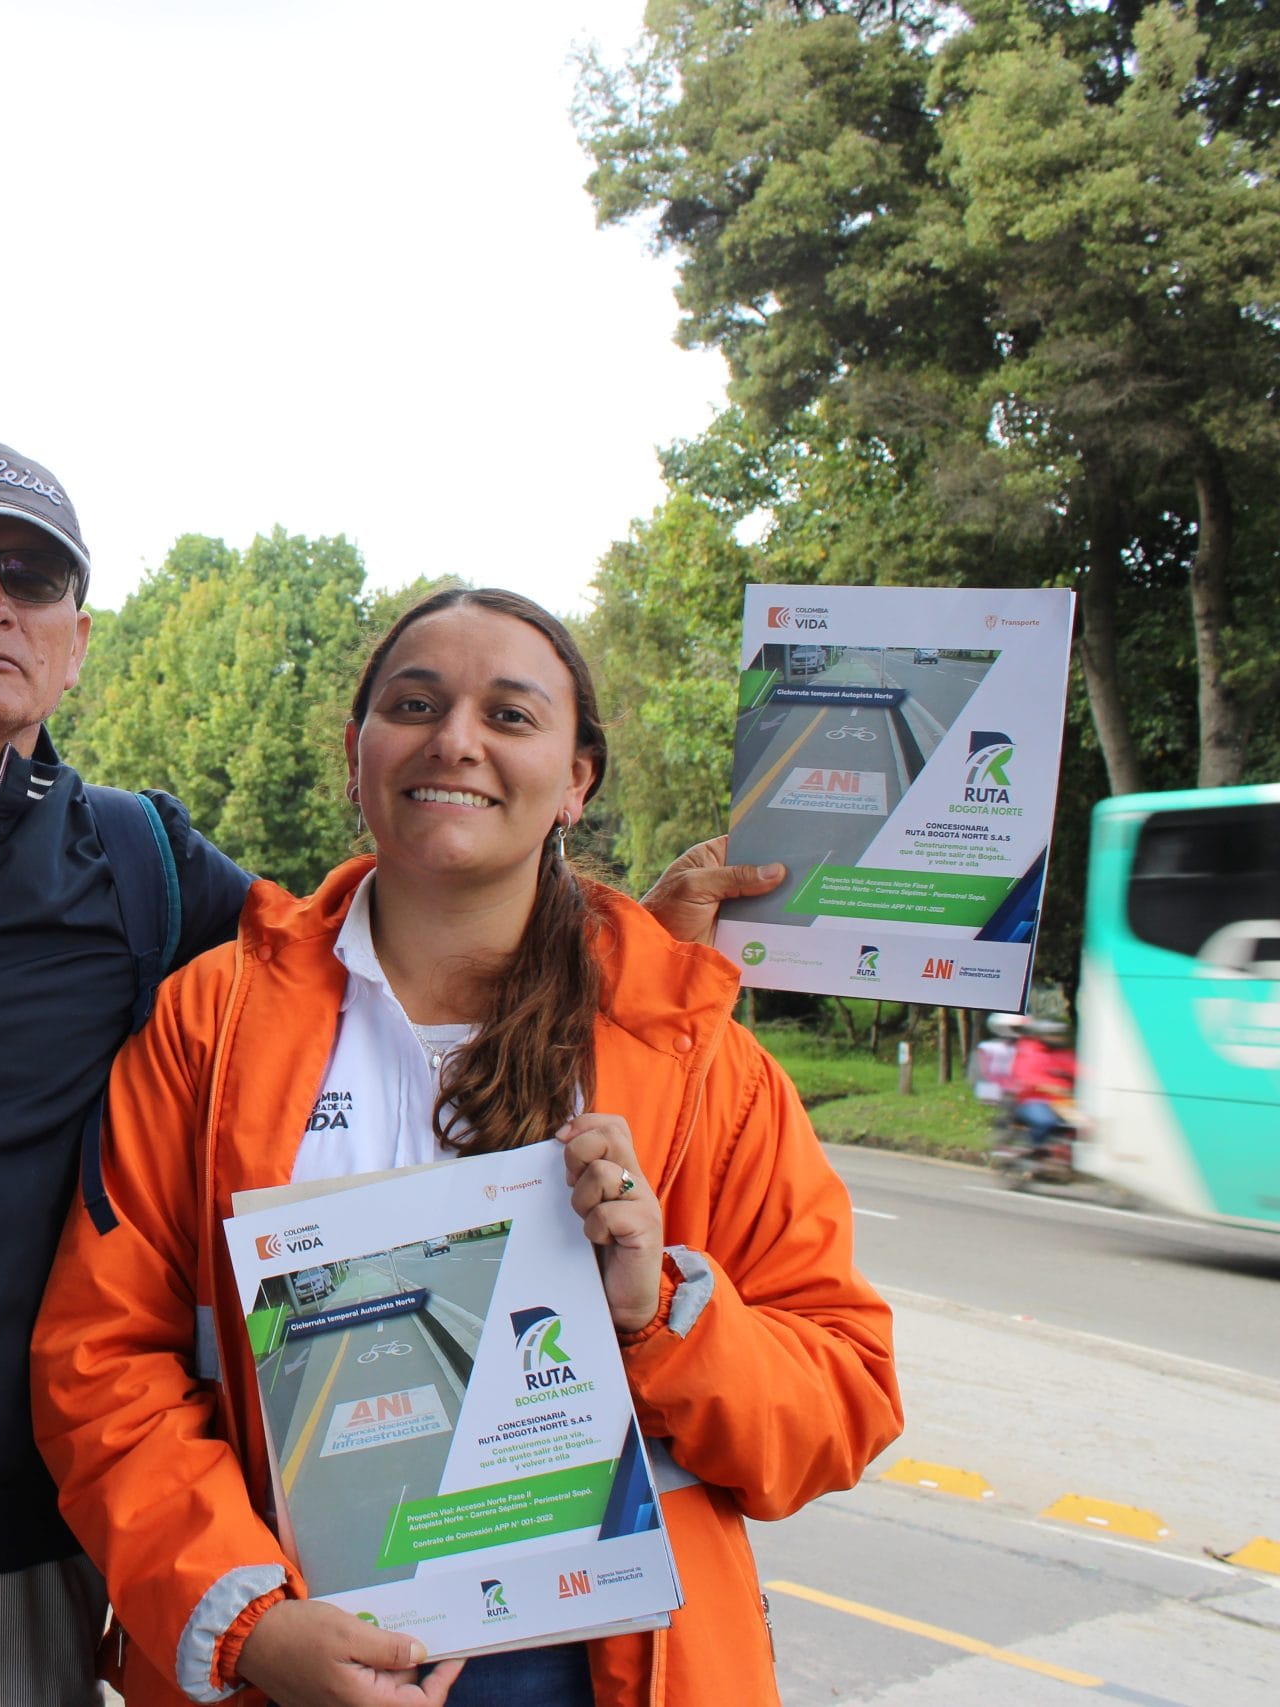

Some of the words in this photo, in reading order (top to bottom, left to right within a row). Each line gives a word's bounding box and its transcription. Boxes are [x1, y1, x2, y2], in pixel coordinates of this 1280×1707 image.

[795, 619, 828, 630] VIDA
[1001, 619, 1040, 628] Transporte
[777, 689, 809, 697] Ciclorruta
[811, 690, 840, 698] temporal
[841, 691, 873, 699] Autopista
[781, 796, 879, 811] Infraestructura
[964, 787, 1010, 804] RUTA
[949, 803, 988, 815] BOGOTÁ
[991, 807, 1023, 816] NORTE
[905, 829, 926, 837] RUTA
[927, 830, 960, 839] BOGOTÁ
[990, 834, 1011, 842] S.A.S
[925, 822, 989, 832] CONCESIONARIA
[913, 841, 968, 851] Construiremos
[743, 947, 764, 959] ST
[856, 968, 876, 977] RUTA
[321, 1091, 353, 1102] MBIA
[305, 1110, 349, 1132] IDA
[501, 1178, 543, 1193] Transporte
[283, 1223, 320, 1237] COLOMBIA
[287, 1236, 324, 1254] VIDA
[290, 1317, 326, 1331] Ciclorruta
[327, 1309, 359, 1323] temporal
[360, 1301, 394, 1316] Autopista
[395, 1297, 416, 1307] Norte
[525, 1365, 577, 1391] RUTA
[515, 1387, 559, 1407] BOGOTÁ
[560, 1380, 596, 1397] NORTE
[337, 1425, 376, 1440] Agencia
[378, 1419, 420, 1431] Nacional
[497, 1410, 567, 1432] CONCESIONARIA
[332, 1421, 441, 1450] Infraestructura
[478, 1434, 501, 1446] RUTA
[502, 1426, 538, 1440] BOGOTÁ
[539, 1419, 569, 1432] NORTE
[570, 1414, 593, 1425] S.A.S
[491, 1436, 551, 1456] Construiremos
[552, 1433, 568, 1442] una
[569, 1430, 585, 1439] vía,
[479, 1459, 495, 1469] que
[496, 1455, 507, 1465] dé
[508, 1450, 533, 1464] gusto
[533, 1446, 552, 1457] salir
[553, 1443, 564, 1453] de
[565, 1437, 602, 1450] Bogotá...
[515, 1463, 521, 1471] y
[522, 1457, 546, 1468] volver
[554, 1453, 570, 1462] ella
[407, 1510, 439, 1524] Proyecto
[439, 1507, 455, 1516] Vial:
[456, 1502, 486, 1514] Accesos
[486, 1496, 507, 1507] Norte
[508, 1492, 526, 1503] Fase
[526, 1490, 532, 1498] II
[409, 1519, 443, 1532] Autopista
[444, 1514, 464, 1525] Norte
[469, 1508, 497, 1520] Carrera
[498, 1501, 528, 1515] Séptima
[533, 1491, 571, 1506] Perimetral
[412, 1536, 444, 1549] Contrato
[445, 1533, 454, 1542] de
[455, 1526, 493, 1540] Concesión
[494, 1521, 510, 1533] APP
[520, 1513, 554, 1528] 001-2022
[597, 1571, 643, 1586] Infraestructura
[486, 1606, 510, 1618] RUTA
